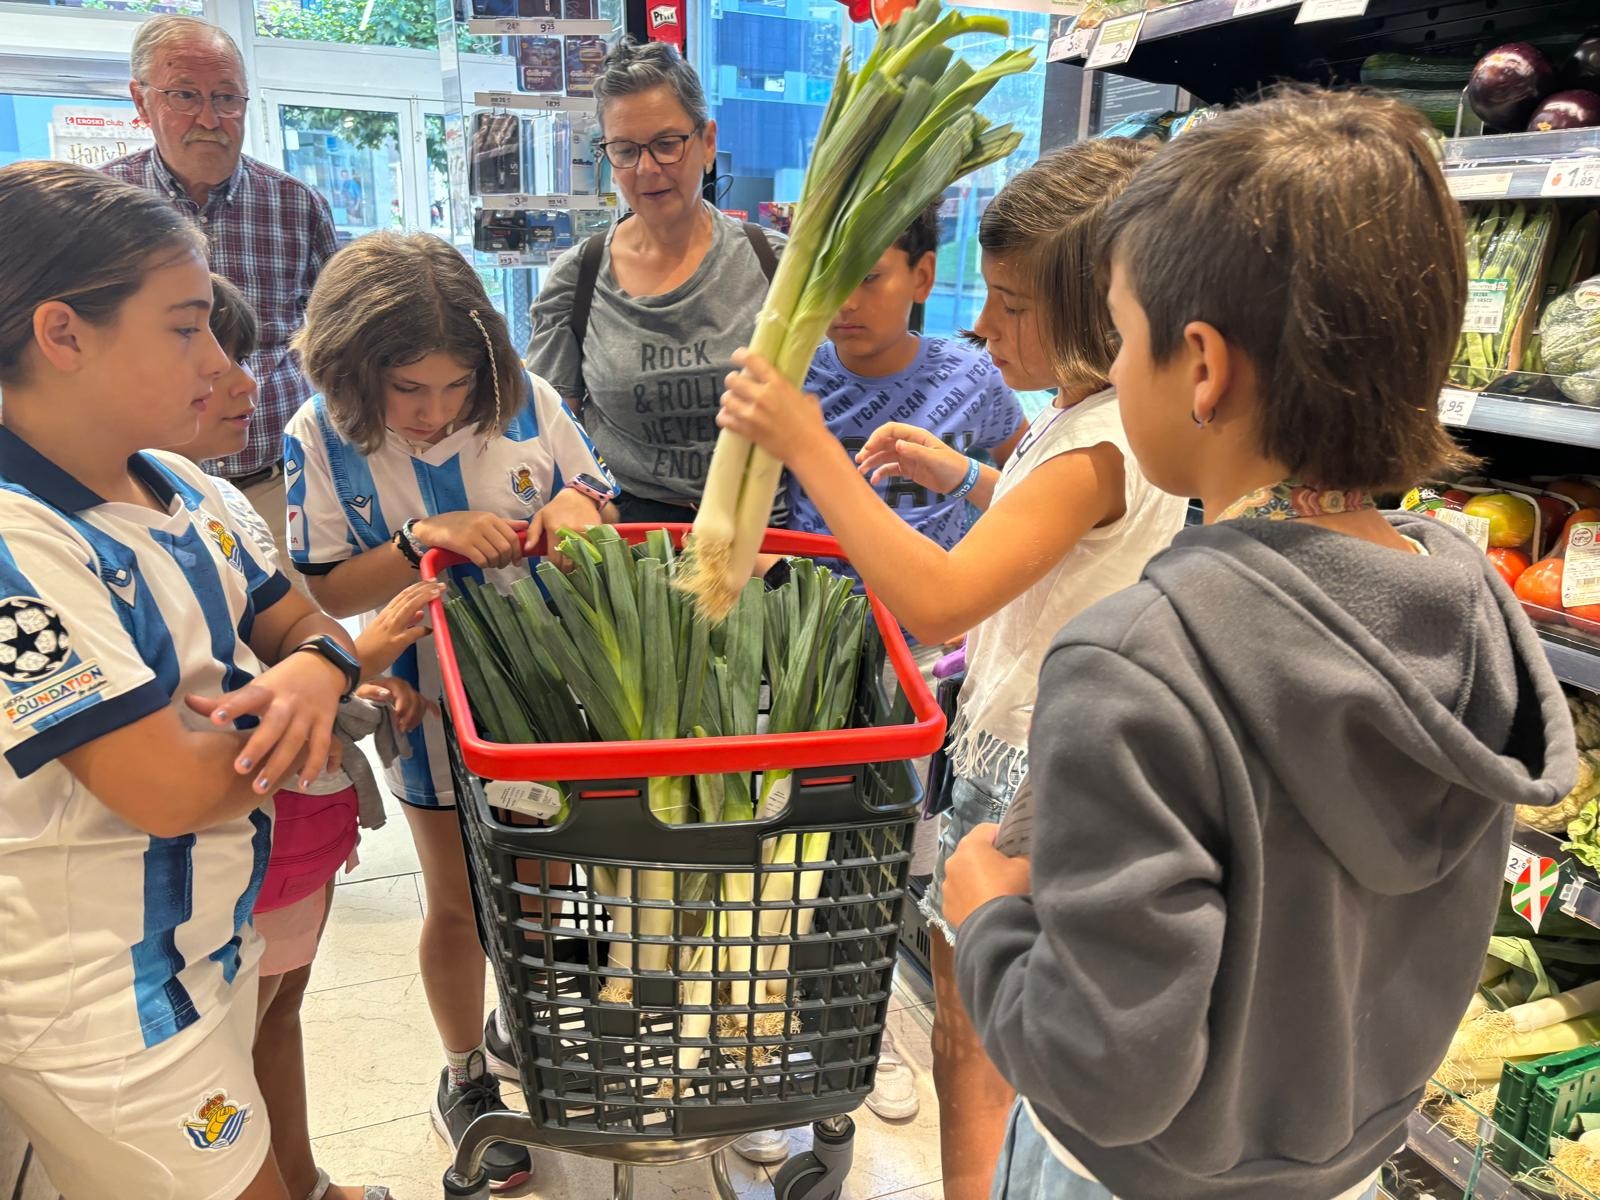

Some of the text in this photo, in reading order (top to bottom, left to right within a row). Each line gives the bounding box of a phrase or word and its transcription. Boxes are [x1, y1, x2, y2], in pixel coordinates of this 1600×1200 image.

[641, 340, 711, 371] ROCK
[634, 383, 653, 414] &
[652, 450, 714, 480] END
[6, 667, 104, 720] FOUNDATION
